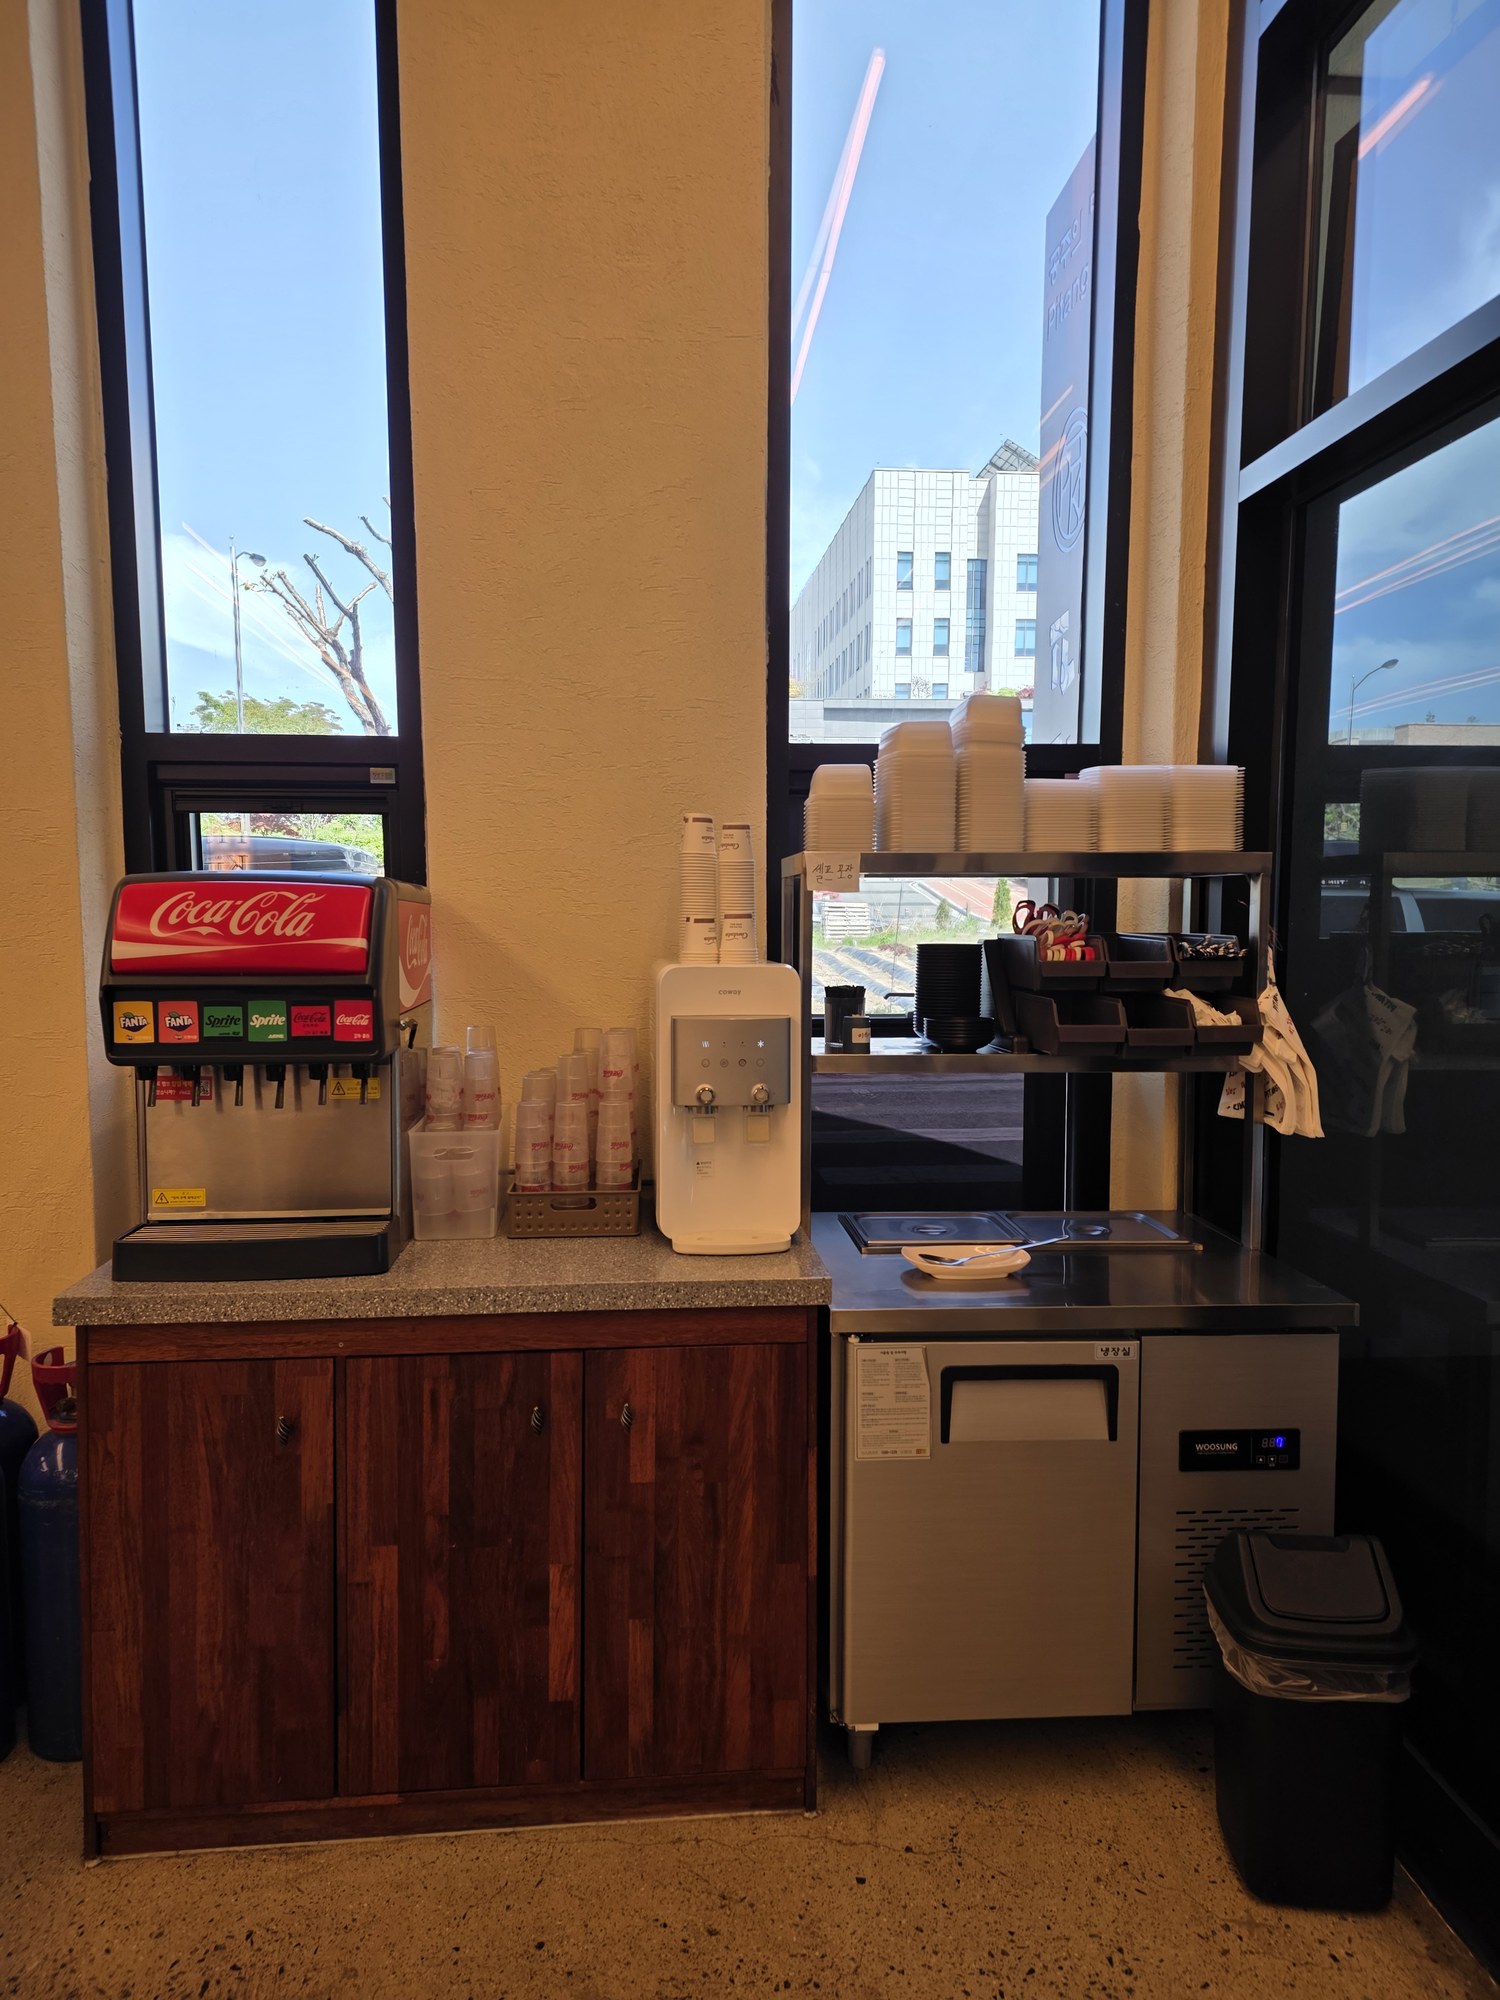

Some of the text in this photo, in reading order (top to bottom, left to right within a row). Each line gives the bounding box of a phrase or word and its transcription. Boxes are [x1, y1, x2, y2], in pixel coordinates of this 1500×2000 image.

[150, 890, 327, 938] Coca-Cola
[718, 989, 742, 997] coway
[120, 1016, 148, 1028] FANTA
[165, 1015, 193, 1027] FANTA
[205, 1014, 241, 1028] Sprite
[250, 1014, 286, 1028] Sprite
[1100, 1346, 1131, 1357] 냉장실
[1195, 1443, 1238, 1451] WOOSUNG
